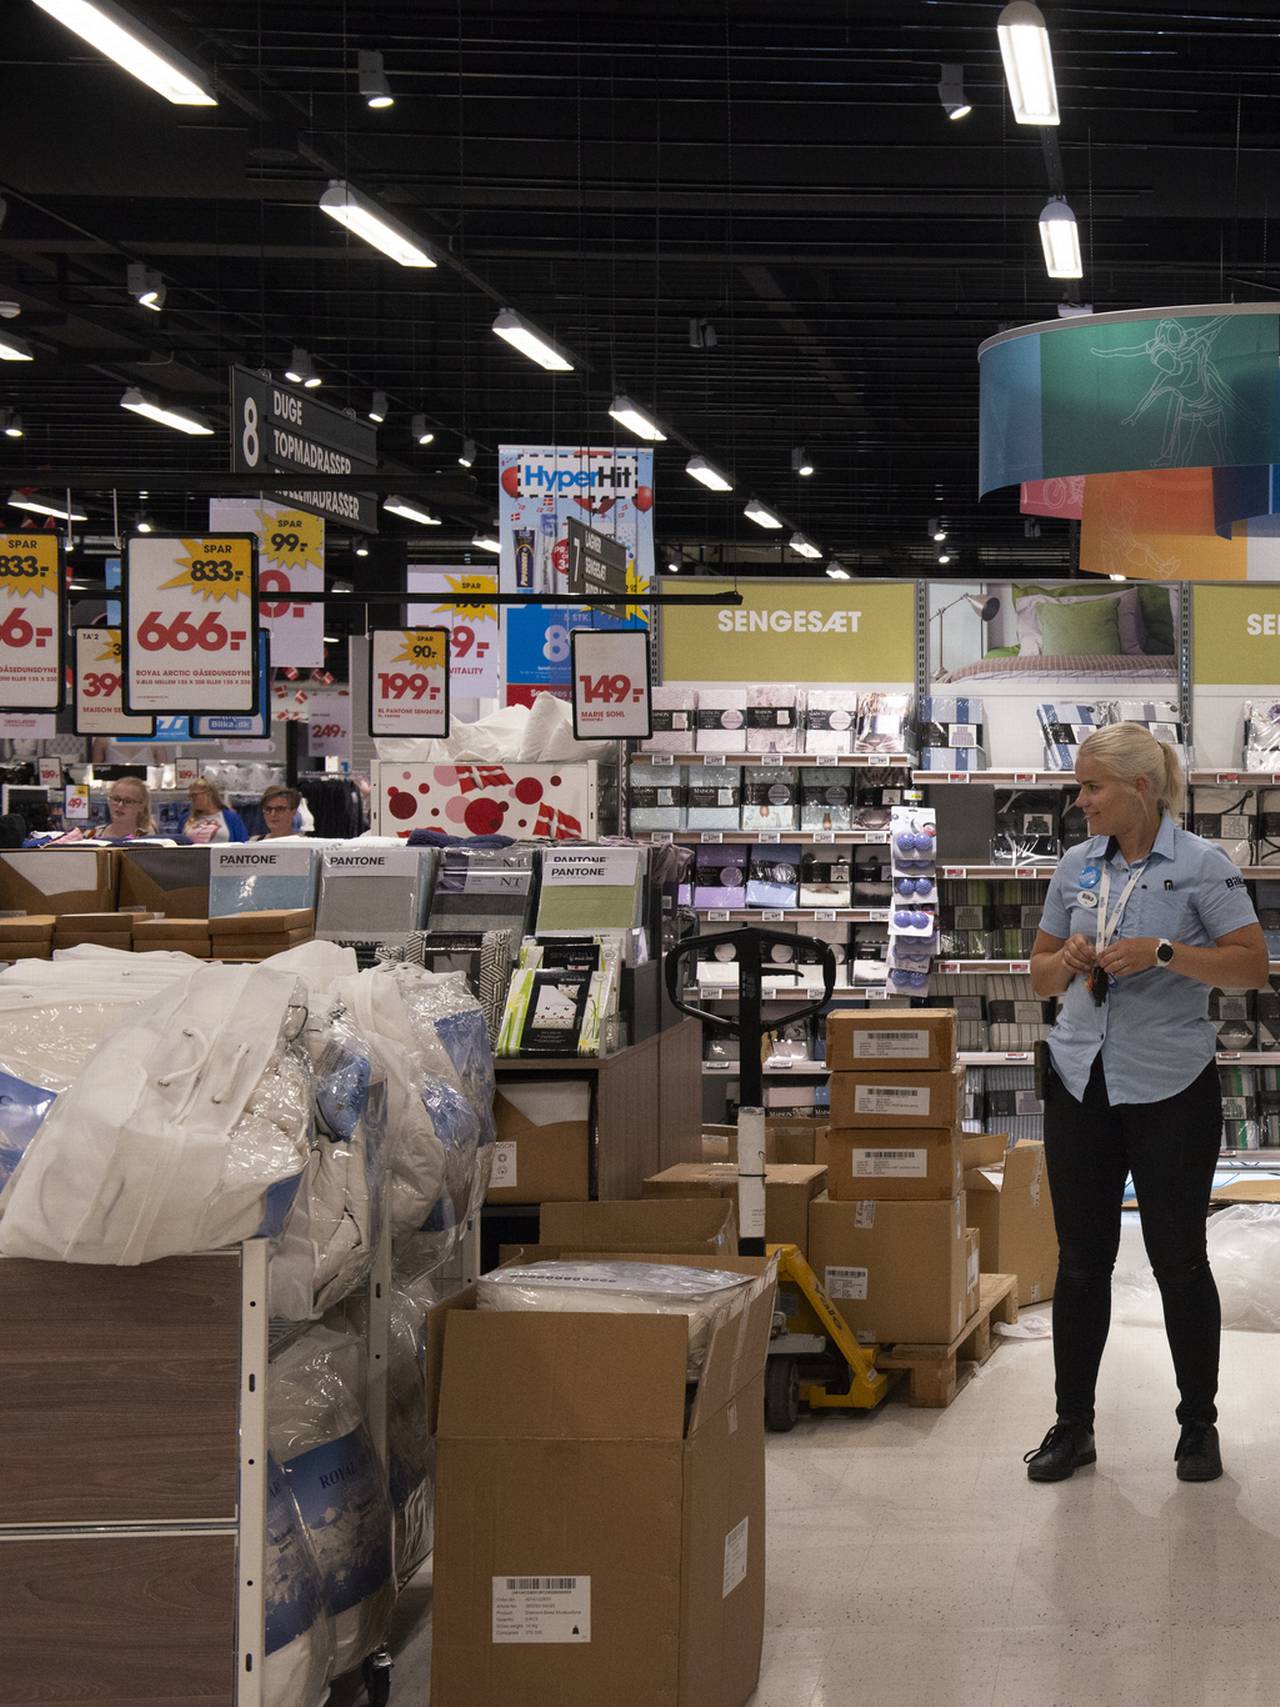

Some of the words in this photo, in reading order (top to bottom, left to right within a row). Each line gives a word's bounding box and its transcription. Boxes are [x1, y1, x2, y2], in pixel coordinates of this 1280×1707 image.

[273, 391, 302, 425] DUGE
[243, 397, 258, 467] 8
[273, 430, 351, 474] TOPMADRASSER
[525, 465, 631, 491] HyperHit
[275, 490, 359, 520] MADRASSER
[277, 520, 302, 528] SPAR
[8, 540, 37, 549] SPAR
[204, 545, 232, 553] SPAR
[718, 610, 862, 633] SENGESÆT
[220, 855, 277, 864] PANTONE
[330, 856, 385, 866] PANTONE
[552, 868, 605, 876] PANTONE
